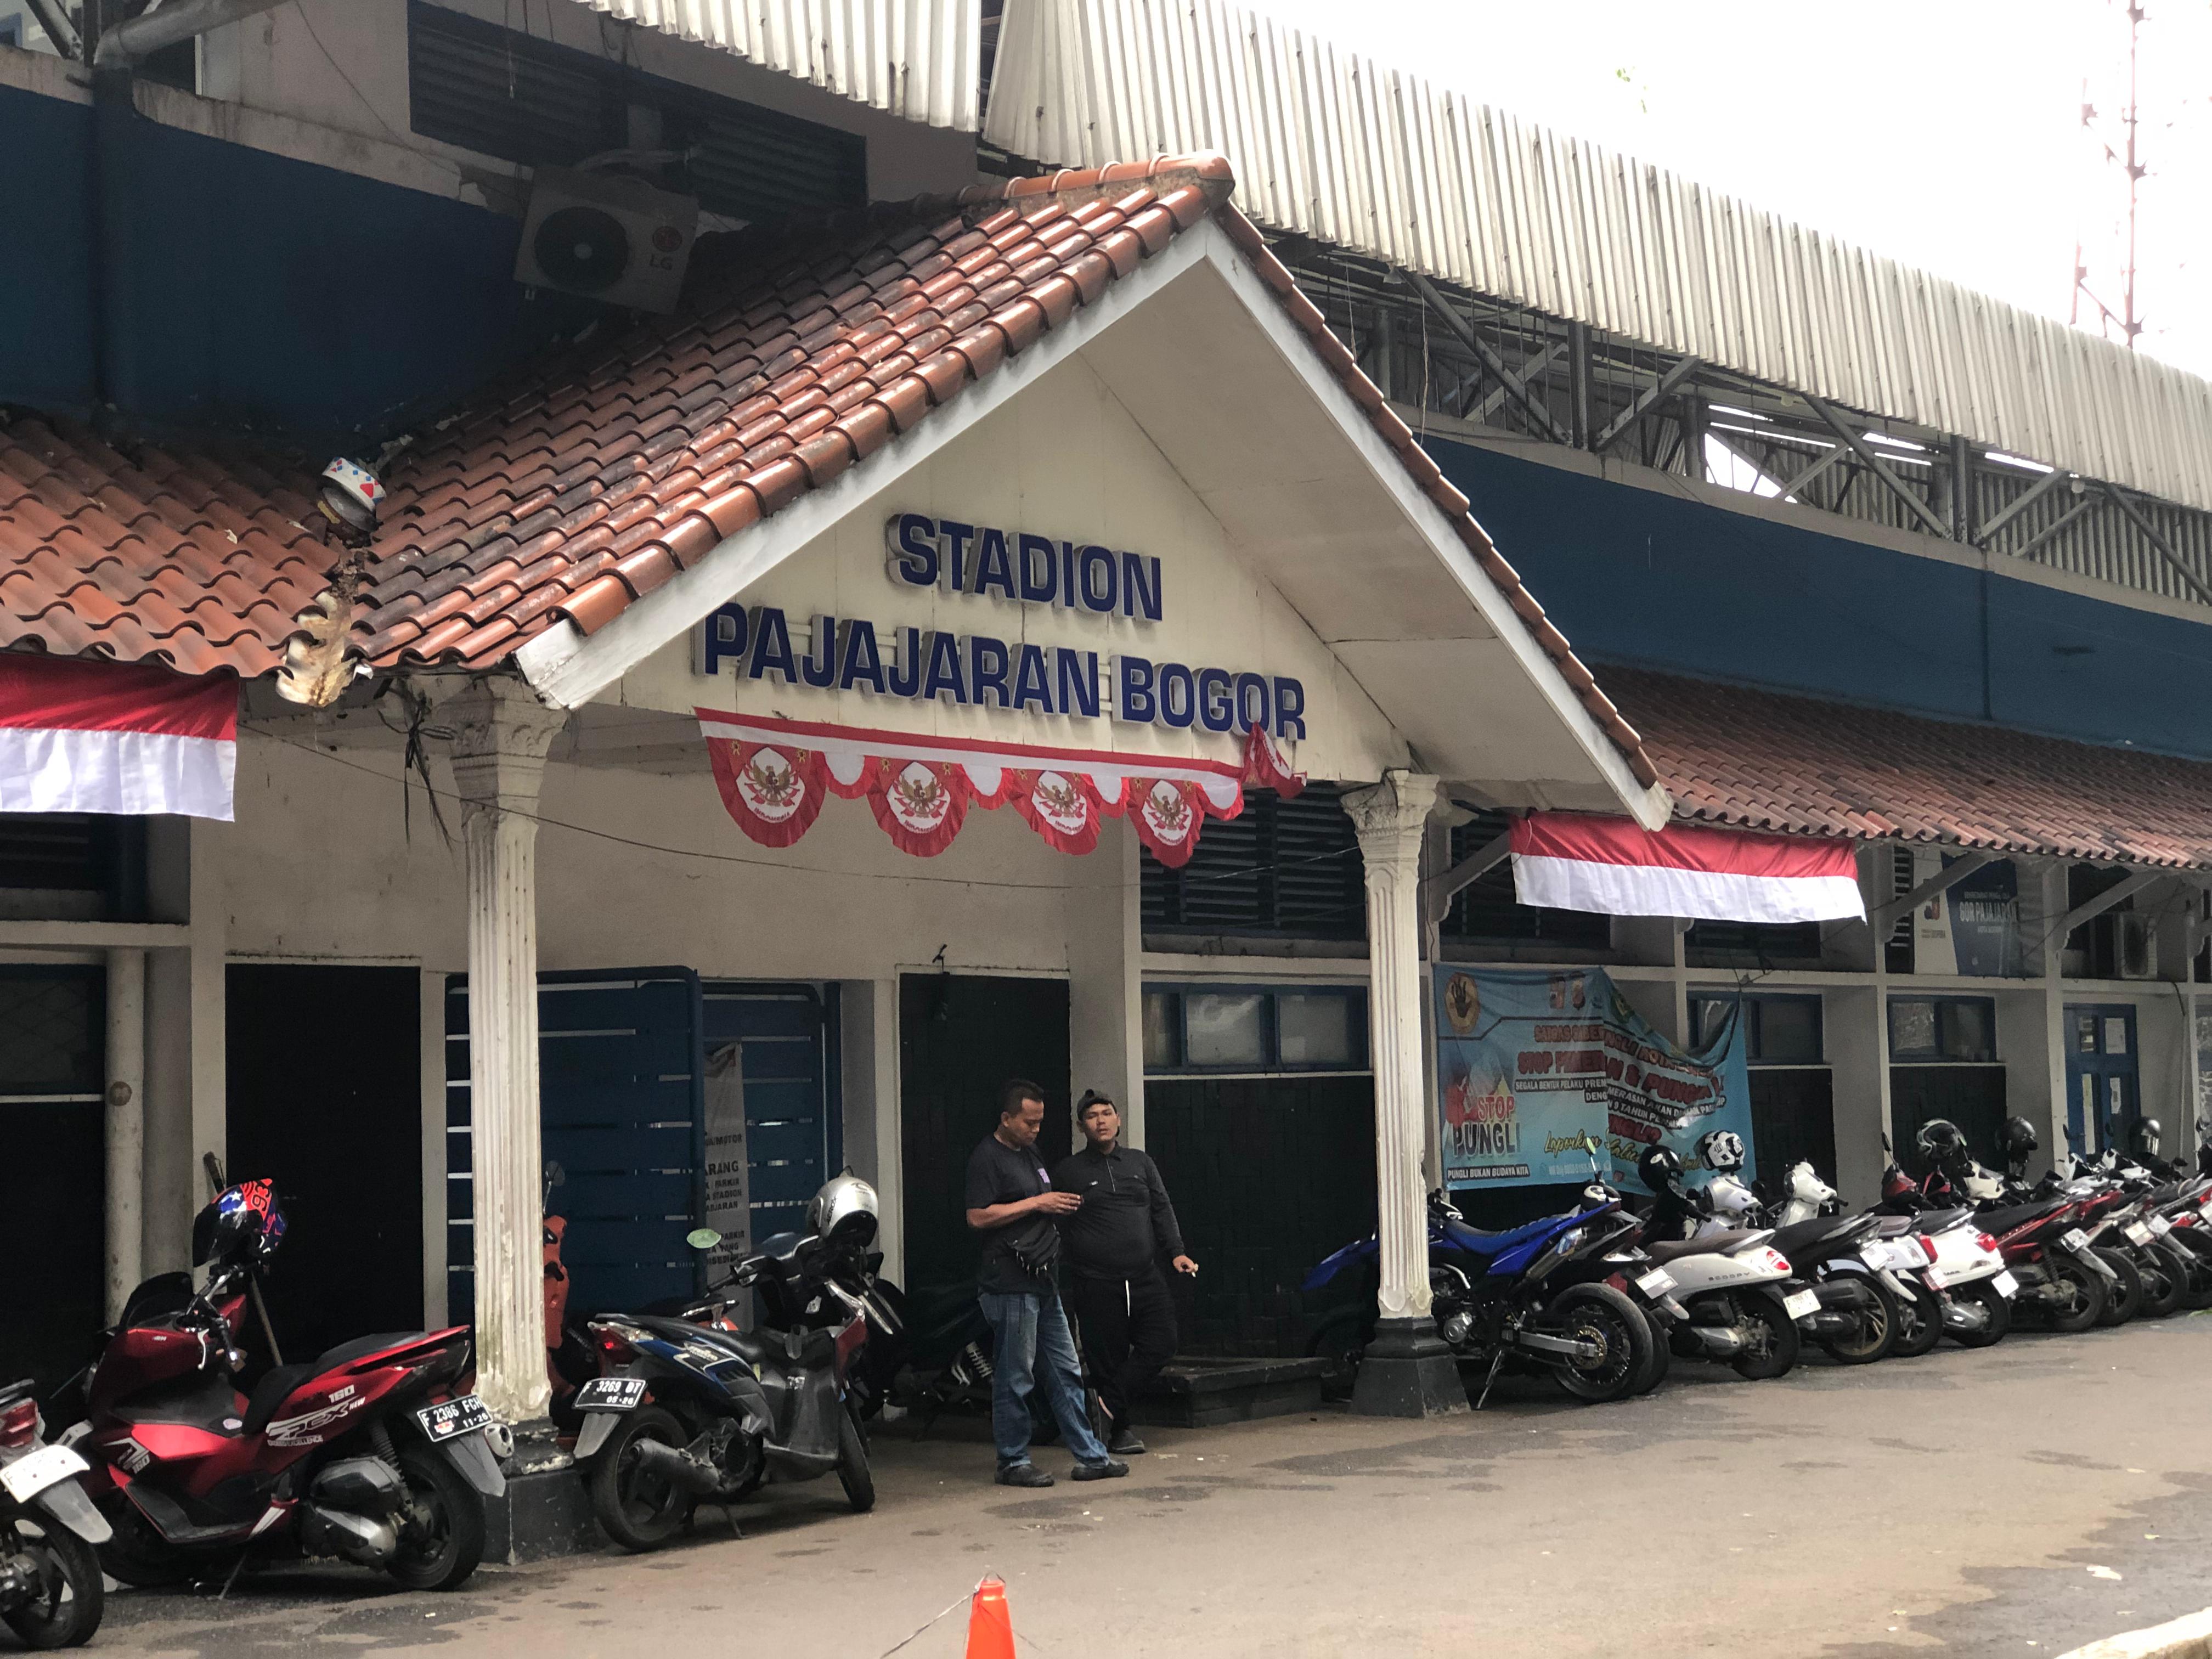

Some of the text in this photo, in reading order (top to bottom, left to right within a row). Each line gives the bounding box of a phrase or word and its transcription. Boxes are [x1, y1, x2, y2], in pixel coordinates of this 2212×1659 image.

[649, 253, 673, 270] LG
[892, 513, 1163, 622] STADION
[700, 602, 1307, 741] PAJAJARAN BOGOR
[1960, 901, 1974, 922] GOR
[1515, 1080, 1538, 1090] SEGALA
[1539, 1080, 1559, 1090] BENTUK
[1560, 1079, 1583, 1088] PELAKU
[1477, 1095, 1515, 1121] STOP
[1453, 1122, 1520, 1156] PUNGLI
[1448, 1169, 1469, 1179] PUNGLI
[1470, 1167, 1491, 1177] BUKAN
[1516, 1165, 1529, 1175] KITA
[713, 1189, 742, 1200] STADION
[1708, 1272, 1750, 1281] SCOOPY
[329, 1384, 355, 1403] 160
[583, 1382, 592, 1393] F
[596, 1380, 622, 1392] 3269
[349, 1397, 366, 1410] NEW
[421, 1396, 483, 1427] F 2386 FCH
